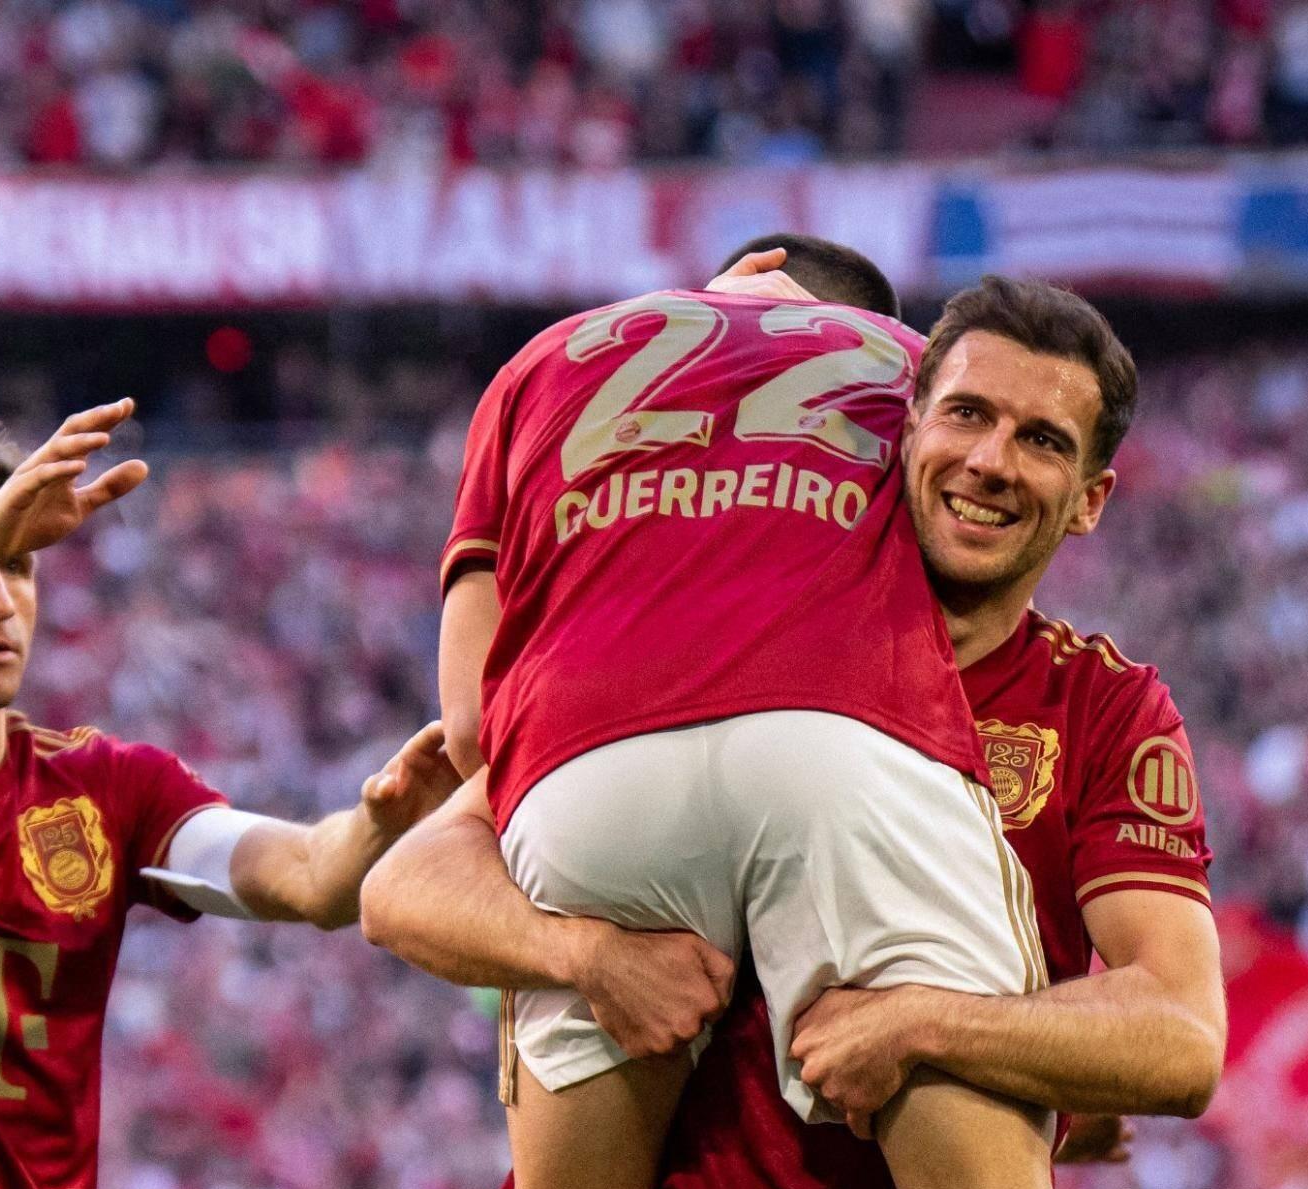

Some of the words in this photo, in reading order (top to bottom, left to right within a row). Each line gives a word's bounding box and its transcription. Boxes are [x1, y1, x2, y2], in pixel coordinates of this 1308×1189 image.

[560, 294, 915, 482] 22
[554, 462, 870, 544] GUERREIRO
[985, 742, 1031, 768] 125
[37, 821, 80, 852] 125
[1115, 822, 1198, 859] Allian
